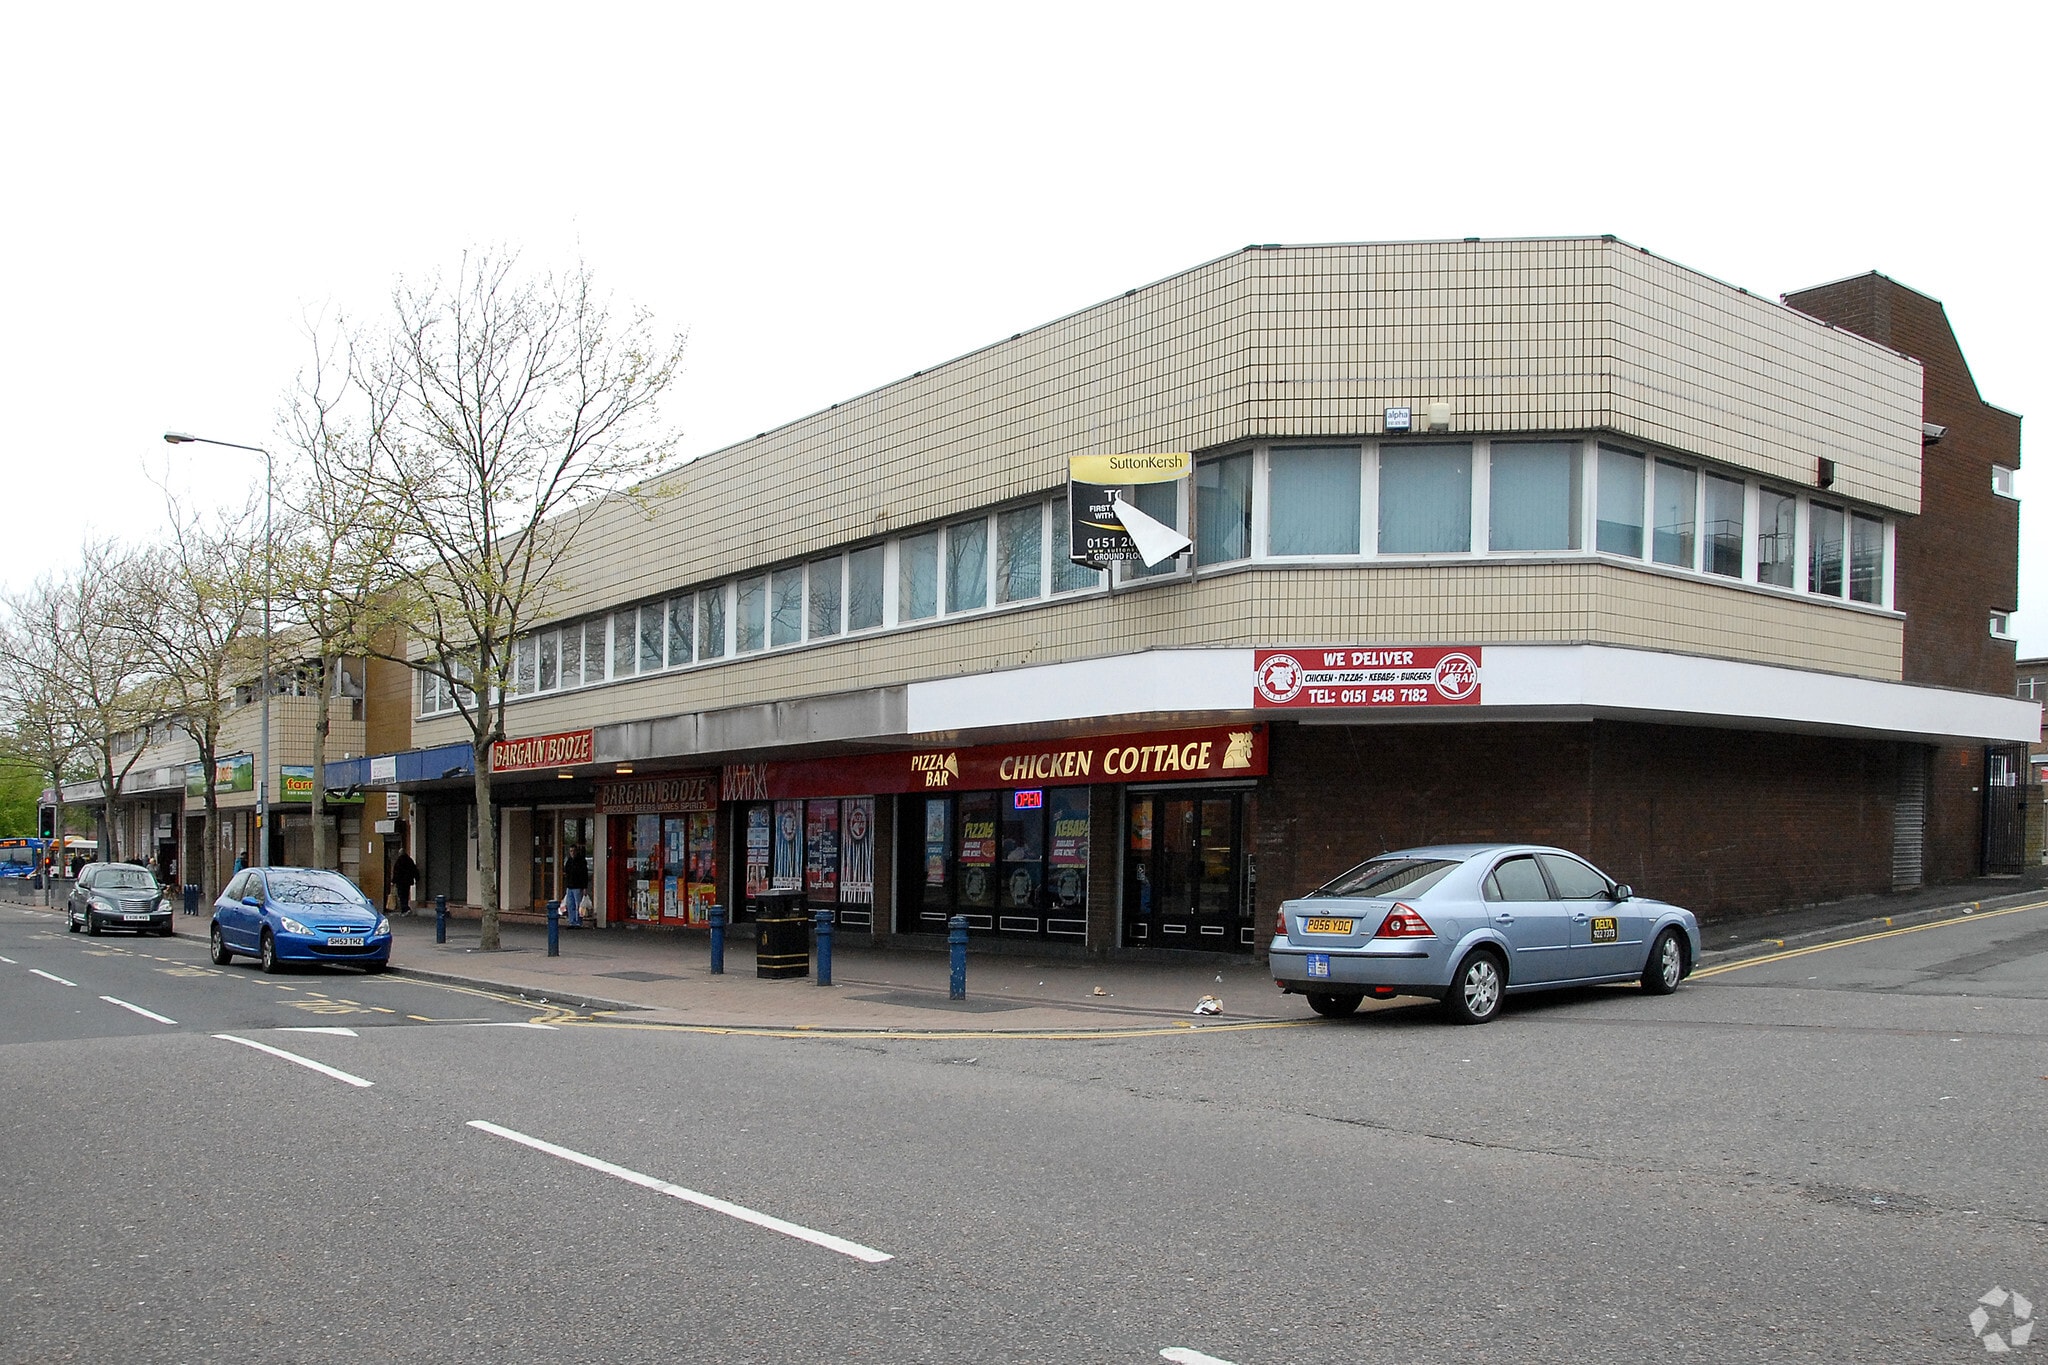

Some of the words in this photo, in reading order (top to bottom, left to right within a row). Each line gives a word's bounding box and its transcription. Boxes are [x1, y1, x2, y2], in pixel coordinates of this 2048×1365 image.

[1387, 410, 1408, 421] alpha
[1110, 455, 1183, 469] SuttonKersh
[1089, 505, 1111, 513] FIRST
[1094, 511, 1114, 519] WITH
[1087, 538, 1116, 549] 0151
[1094, 552, 1125, 561] GROUND
[1323, 652, 1346, 666] WE
[1351, 651, 1414, 666] DELIVER
[1439, 663, 1472, 673] PIZZA
[1305, 674, 1334, 682] CHICKEN
[1338, 673, 1364, 682] PIZZAS
[1368, 672, 1396, 682] KEBABS
[1400, 671, 1432, 681] BURGERS
[1308, 689, 1337, 704] TEL:
[1340, 689, 1367, 703] 0151
[1371, 689, 1395, 702] 548
[1400, 688, 1428, 702] 7182
[496, 740, 545, 767] BARGAIN
[548, 735, 589, 761] BOOZE
[910, 754, 945, 772] PIZZA
[999, 750, 1094, 781] CHICKEN
[1103, 741, 1213, 775] COTTAGE
[925, 769, 949, 787] BAR
[602, 782, 658, 806] BARGAIN
[661, 778, 707, 803] BOOZE
[1016, 793, 1041, 807] OPEN
[602, 805, 633, 813] DISCOUNT
[634, 804, 656, 812] BEERS
[657, 803, 679, 811] WINES
[680, 801, 708, 810] SPIRITS
[1333, 920, 1350, 932] YDC
[1595, 919, 1613, 930] DELTA
[330, 937, 348, 945] SH53
